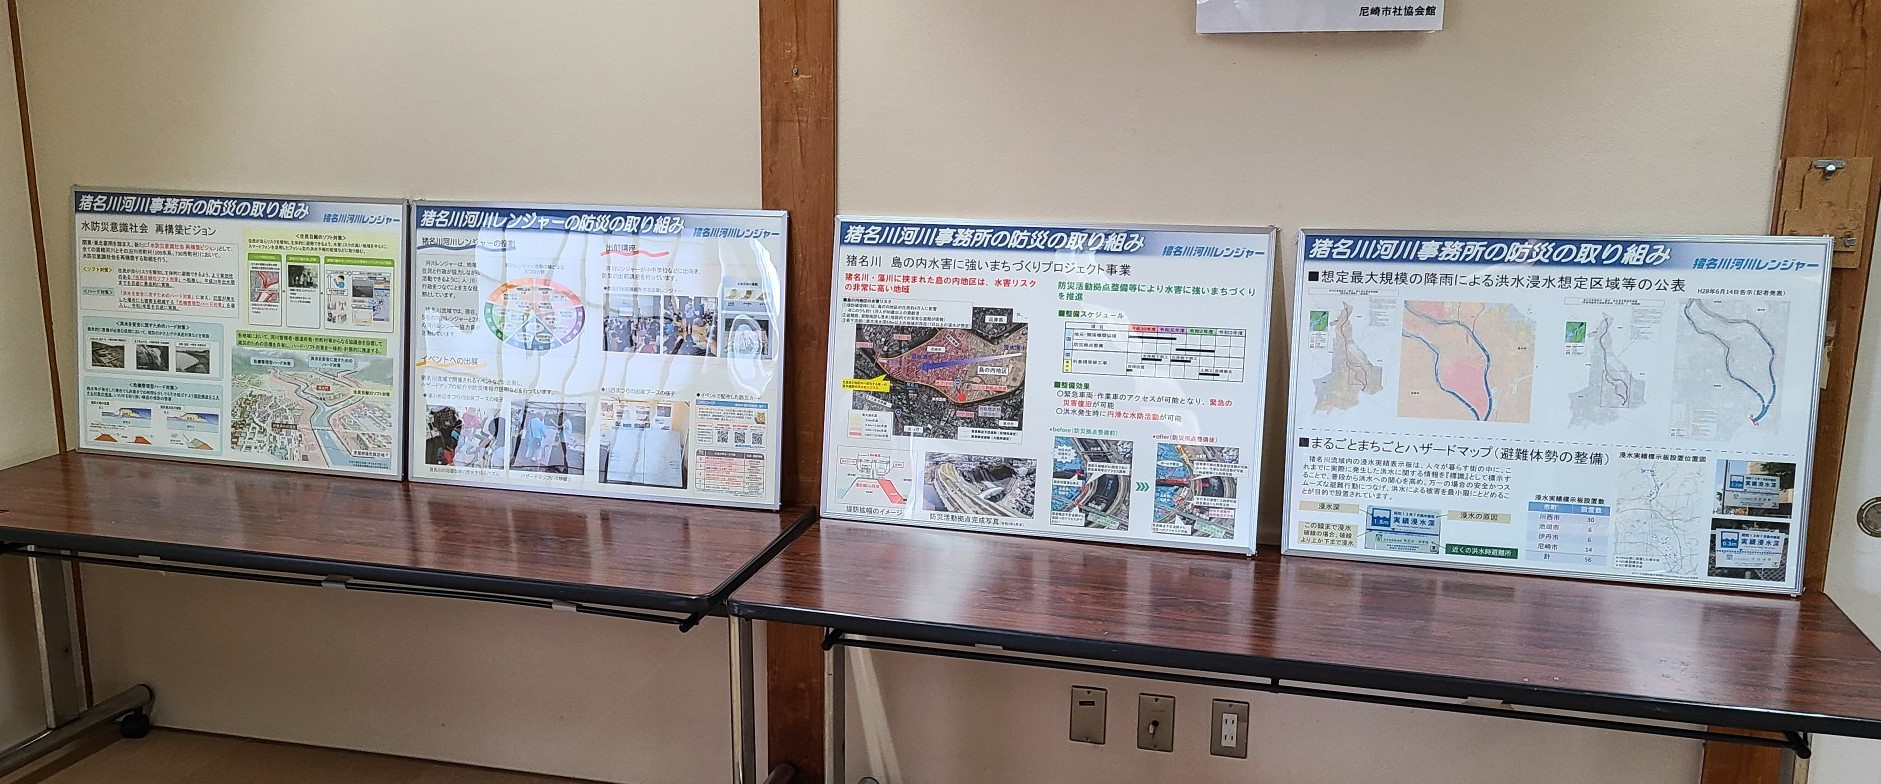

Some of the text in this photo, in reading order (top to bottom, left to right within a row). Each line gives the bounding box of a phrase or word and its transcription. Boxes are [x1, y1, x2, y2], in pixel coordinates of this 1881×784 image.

[1359, 6, 1437, 17] 尼崎市社協会館
[78, 194, 309, 219] 猪名川河川事務所の防災の取り組み
[323, 213, 400, 225] 猪名川河川レンジャー
[420, 209, 685, 234] 猪名川河川レンジャーの防災の取り組み
[81, 221, 217, 236] 水防災意識社会 再構築ビジョン
[693, 227, 780, 239] 猪名川河川レンジャー
[844, 225, 1145, 252] 猪名川河川事務所の防災の取り組み
[1162, 245, 1265, 259] 猪名川河川レンジャー
[1308, 238, 1671, 266] 猪名川河川事務所の防災の取り組み
[846, 254, 1132, 276] 猪名川 島の内水害に強いまちづくりプロジェクト事業
[1692, 257, 1820, 271] 猪名川河川レンジャー
[845, 273, 1036, 288] 猪名川・藻川に挟まれた島の内地区は、水害リスク
[1321, 270, 1686, 293] 想定最大規模の降雨による洪水浸水想定区域等の公表
[844, 284, 910, 294] の非常に高い地域
[1058, 281, 1256, 297] 防災活動拠点整備等により水害に強いまちづくり
[1058, 292, 1083, 301] を推進
[1065, 310, 1124, 319] 整備スケジュール
[1061, 381, 1090, 390] 整備効果
[1063, 400, 1114, 410] 災害復旧が可能
[1302, 489, 1393, 501] とが目的で設置されています。
[846, 505, 903, 516] 堤防拡幅のイメージ
[1460, 511, 1498, 521] 浸水の原因
[930, 512, 999, 525] 防災活動拠点完成写真
[1539, 513, 1560, 521] 川西市
[1304, 522, 1352, 532] この線まで浸水
[1538, 523, 1559, 531] 池田市
[1538, 533, 1559, 541] 伊丹市
[1537, 542, 1558, 551] 尼崎市
